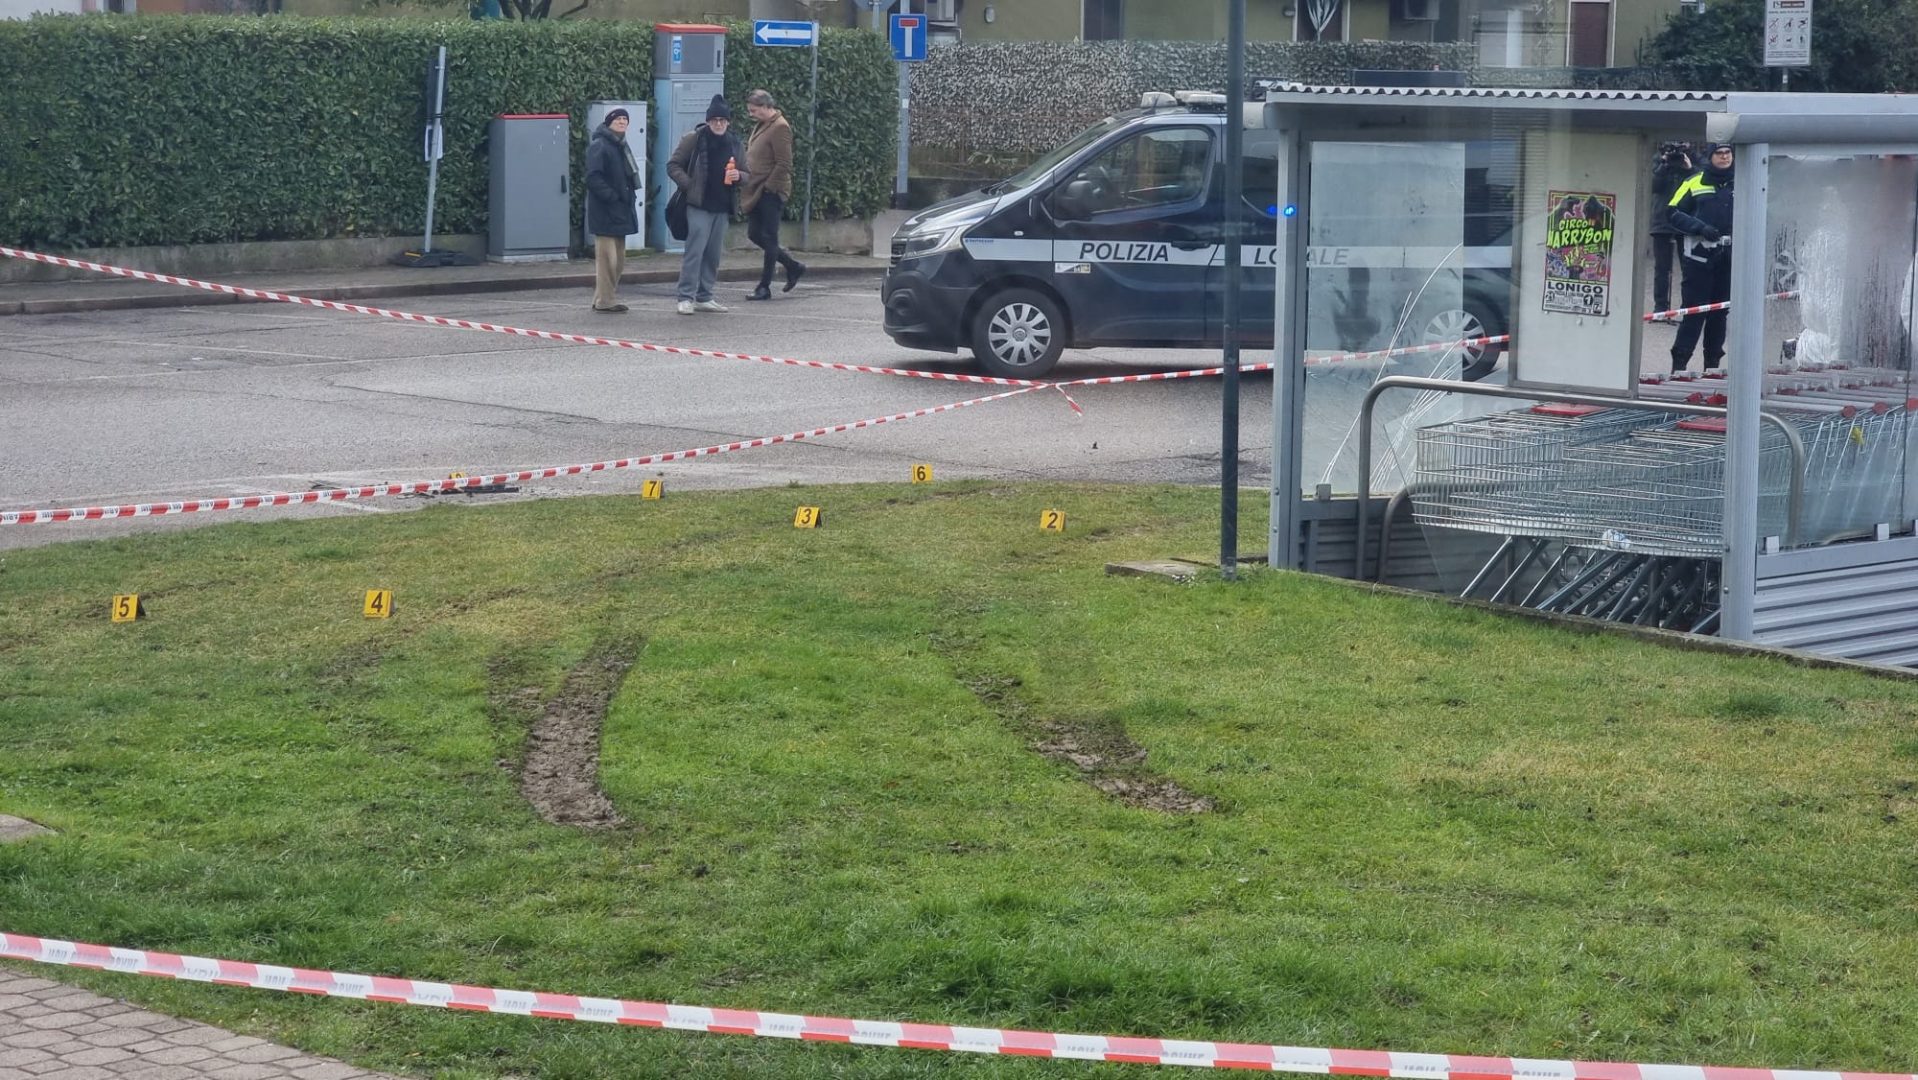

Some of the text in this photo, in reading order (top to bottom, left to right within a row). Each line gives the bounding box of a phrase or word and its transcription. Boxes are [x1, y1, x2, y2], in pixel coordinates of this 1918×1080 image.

[1559, 219, 1588, 231] CIRCO
[1080, 242, 1349, 266] POLIZIA LALE
[1547, 281, 1603, 294] LONIGO
[917, 466, 926, 481] 6
[649, 480, 657, 496] 7
[801, 508, 811, 524] 3
[1047, 512, 1058, 528] 2
[119, 597, 129, 617] 5
[371, 592, 383, 613] 4
